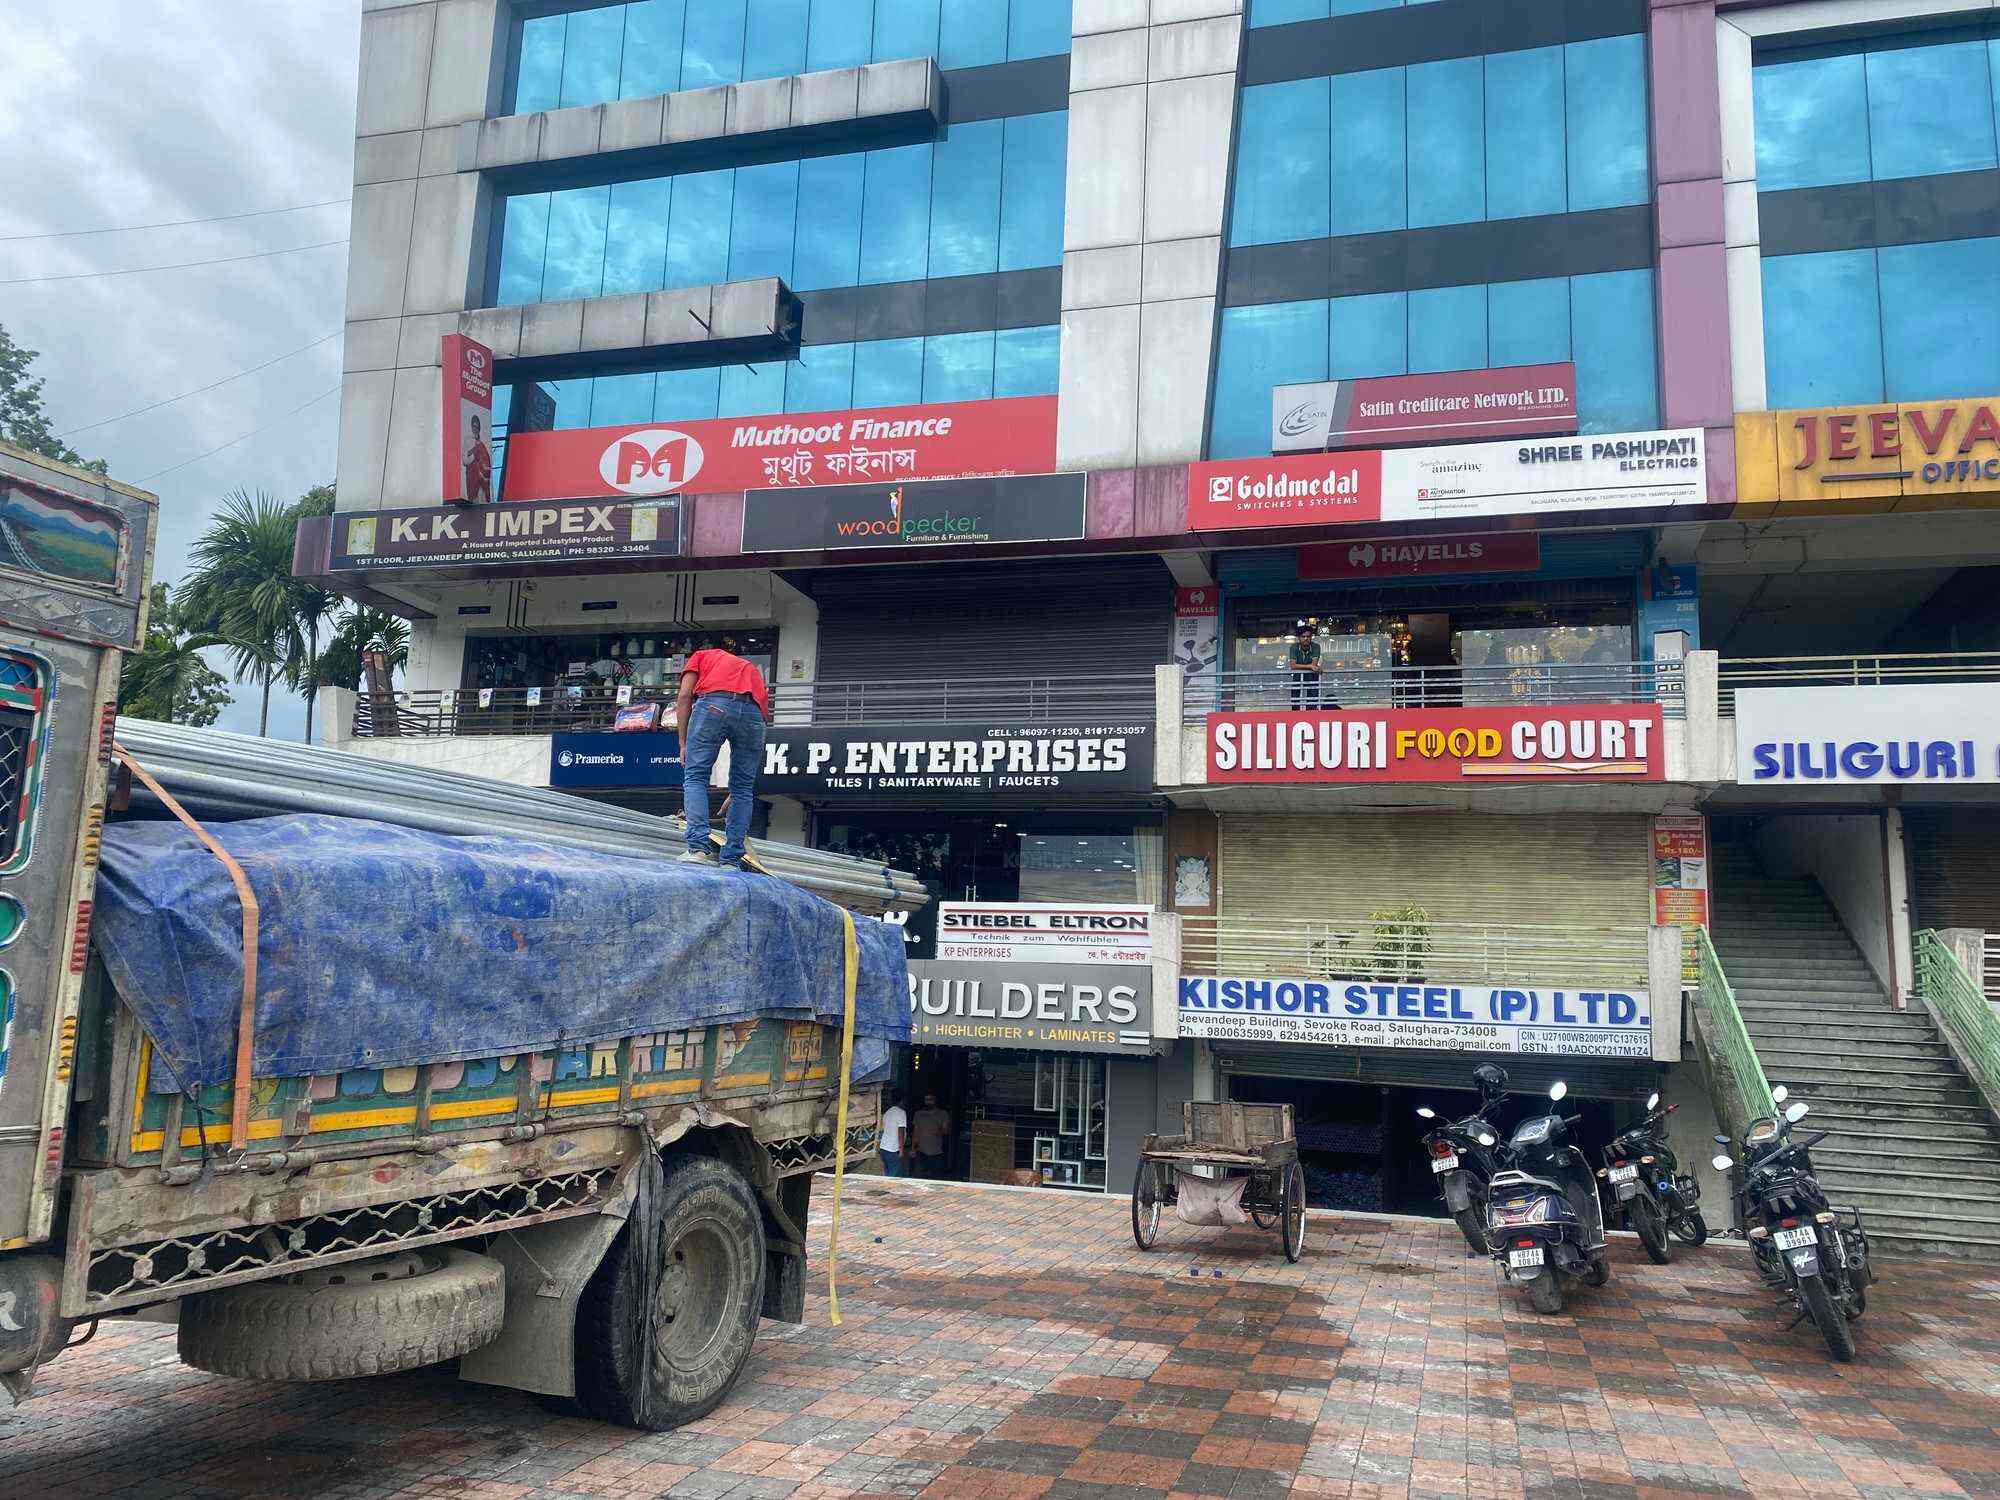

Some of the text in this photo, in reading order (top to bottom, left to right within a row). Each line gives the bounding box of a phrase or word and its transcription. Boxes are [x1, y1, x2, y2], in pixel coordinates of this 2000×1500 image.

[462, 370, 490, 390] Muthoot
[466, 381, 487, 397] Group
[1359, 387, 1569, 417] Satin Creditcare Network LTD.
[731, 417, 952, 448] Muthoot Finance
[1794, 406, 2000, 470] JEEVA
[1518, 437, 1696, 464] SHREE PASHUPATI
[1619, 457, 1698, 472] ELECTRICS
[1237, 468, 1358, 500] Goldmedal
[836, 486, 981, 540] woodpecker
[1236, 501, 1292, 511] SWITCHES
[1309, 497, 1358, 507] SYSTEMS
[390, 505, 616, 543] K.K. IMPEX
[469, 541, 493, 549] House
[505, 539, 541, 548] Imported
[582, 535, 614, 543] Product
[906, 534, 940, 542] Furniture
[948, 532, 989, 541] Furnishing
[373, 556, 404, 565] FLOOR,
[406, 553, 463, 564] JEEVANDEEP
[464, 551, 510, 560] BUILDING,
[511, 549, 561, 558] SALUGARA
[586, 546, 614, 554] 98320
[622, 545, 650, 553] 33404
[1381, 542, 1484, 562] HAVELLS
[987, 729, 1013, 737] CELL
[1215, 719, 1653, 771] SILIGURI FOOD COURT
[575, 752, 624, 765] Pramerica
[763, 738, 1127, 775] K. P. ENTERPRISES
[1753, 740, 1977, 780] SILIGURI
[826, 776, 1060, 788] TILES SANITARYWARE FAUCETS
[943, 913, 1148, 930] STIEBEL ELTRON
[971, 932, 1010, 941] Technik
[944, 946, 1012, 958] KP ENTERPRISES
[1179, 978, 1650, 1026] KISHOR STEEL (P) LTD.
[935, 1024, 1022, 1040] HIGHLIGHTER
[1040, 1029, 1116, 1044] LAMINATES
[1179, 1013, 1497, 1037] Jeevandeep Building, Sevoke Road, Salughara-734008
[1354, 1034, 1385, 1045] e-mail
[1393, 1035, 1511, 1051] pkchachan@gmail.com
[1521, 1031, 1536, 1041] CIN
[1521, 1042, 1549, 1053] GSTN
